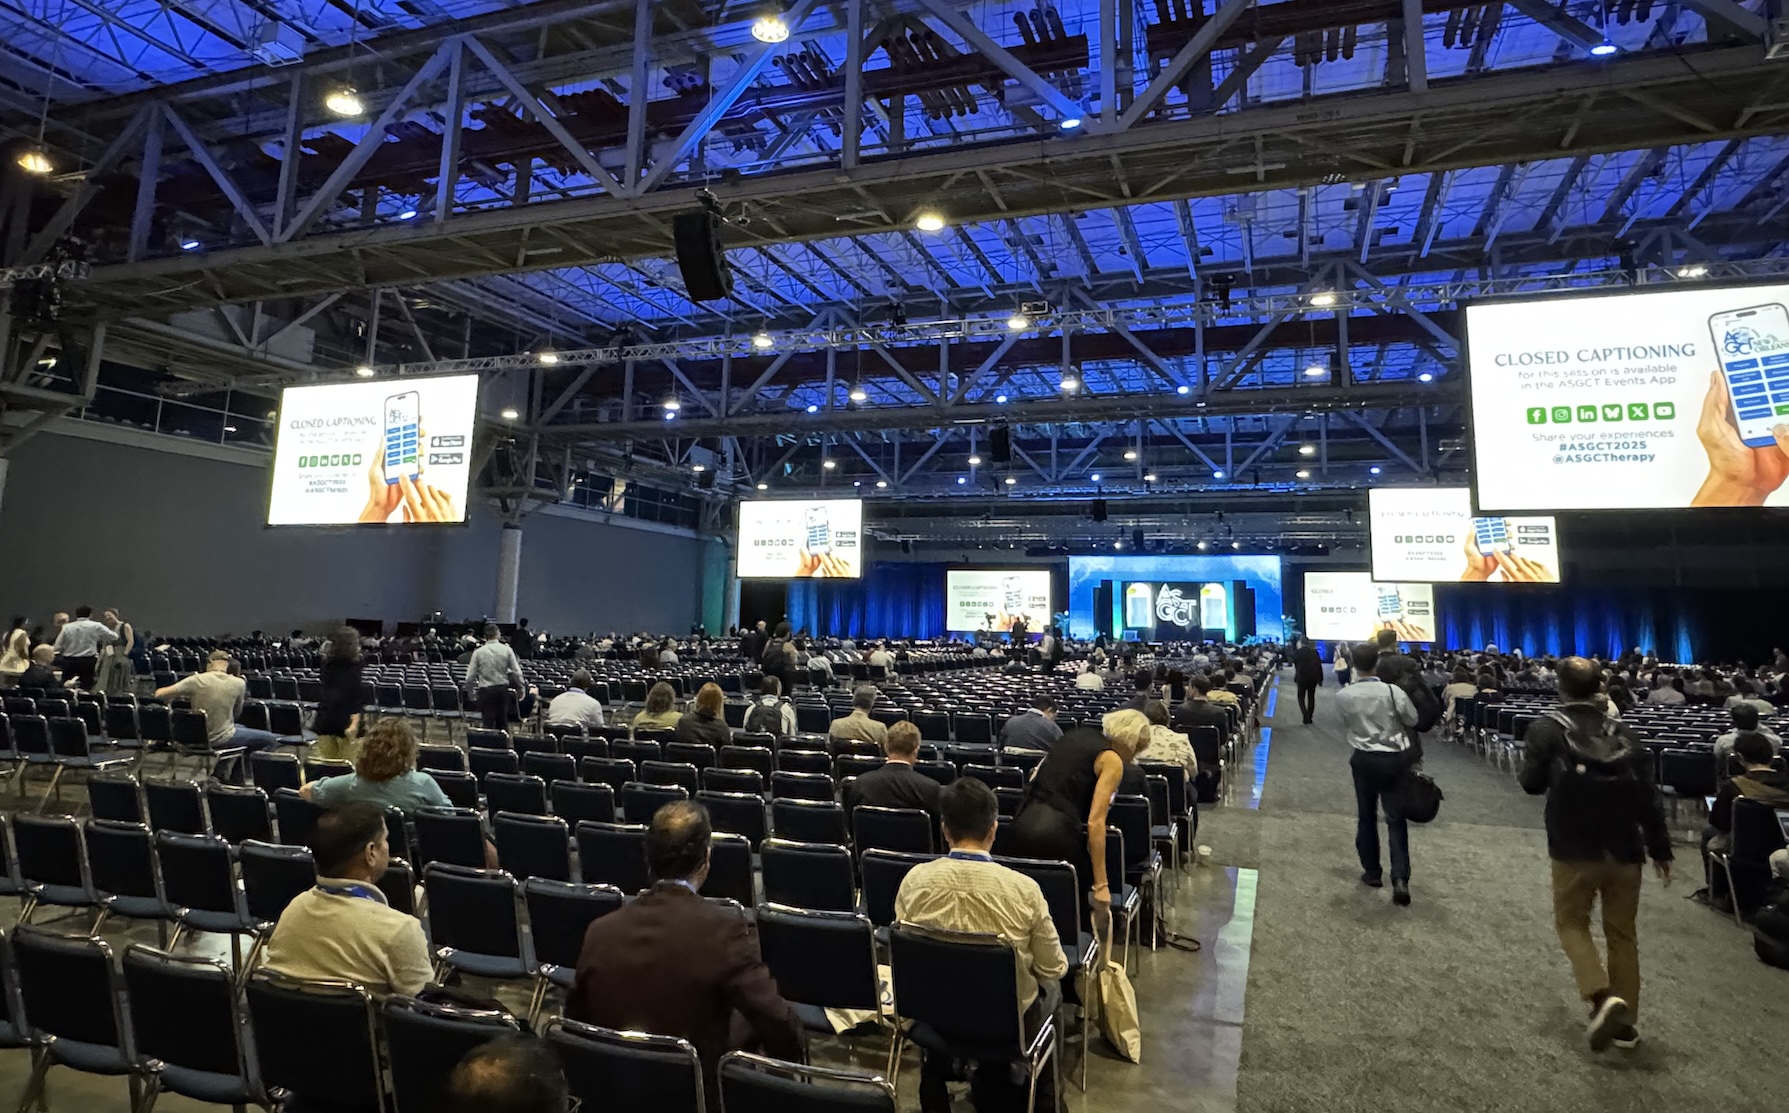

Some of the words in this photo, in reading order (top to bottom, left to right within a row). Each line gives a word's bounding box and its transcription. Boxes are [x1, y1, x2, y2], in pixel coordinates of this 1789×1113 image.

[1494, 350, 1570, 367] CLOSED
[1576, 343, 1696, 363] CAPTIONING
[1563, 368, 1607, 378] sesson
[1623, 363, 1678, 375] available
[1520, 382, 1532, 390] in
[1535, 380, 1555, 390] the
[1558, 378, 1601, 389] ASGCT
[1604, 376, 1646, 387] Events
[1649, 375, 1677, 385] App
[1532, 433, 1566, 442] Share
[1569, 432, 1596, 442] your
[1600, 429, 1675, 441] experiences
[1559, 441, 1647, 452] #ASGCT2025
[1552, 453, 1656, 464] @ASGCTherapy
